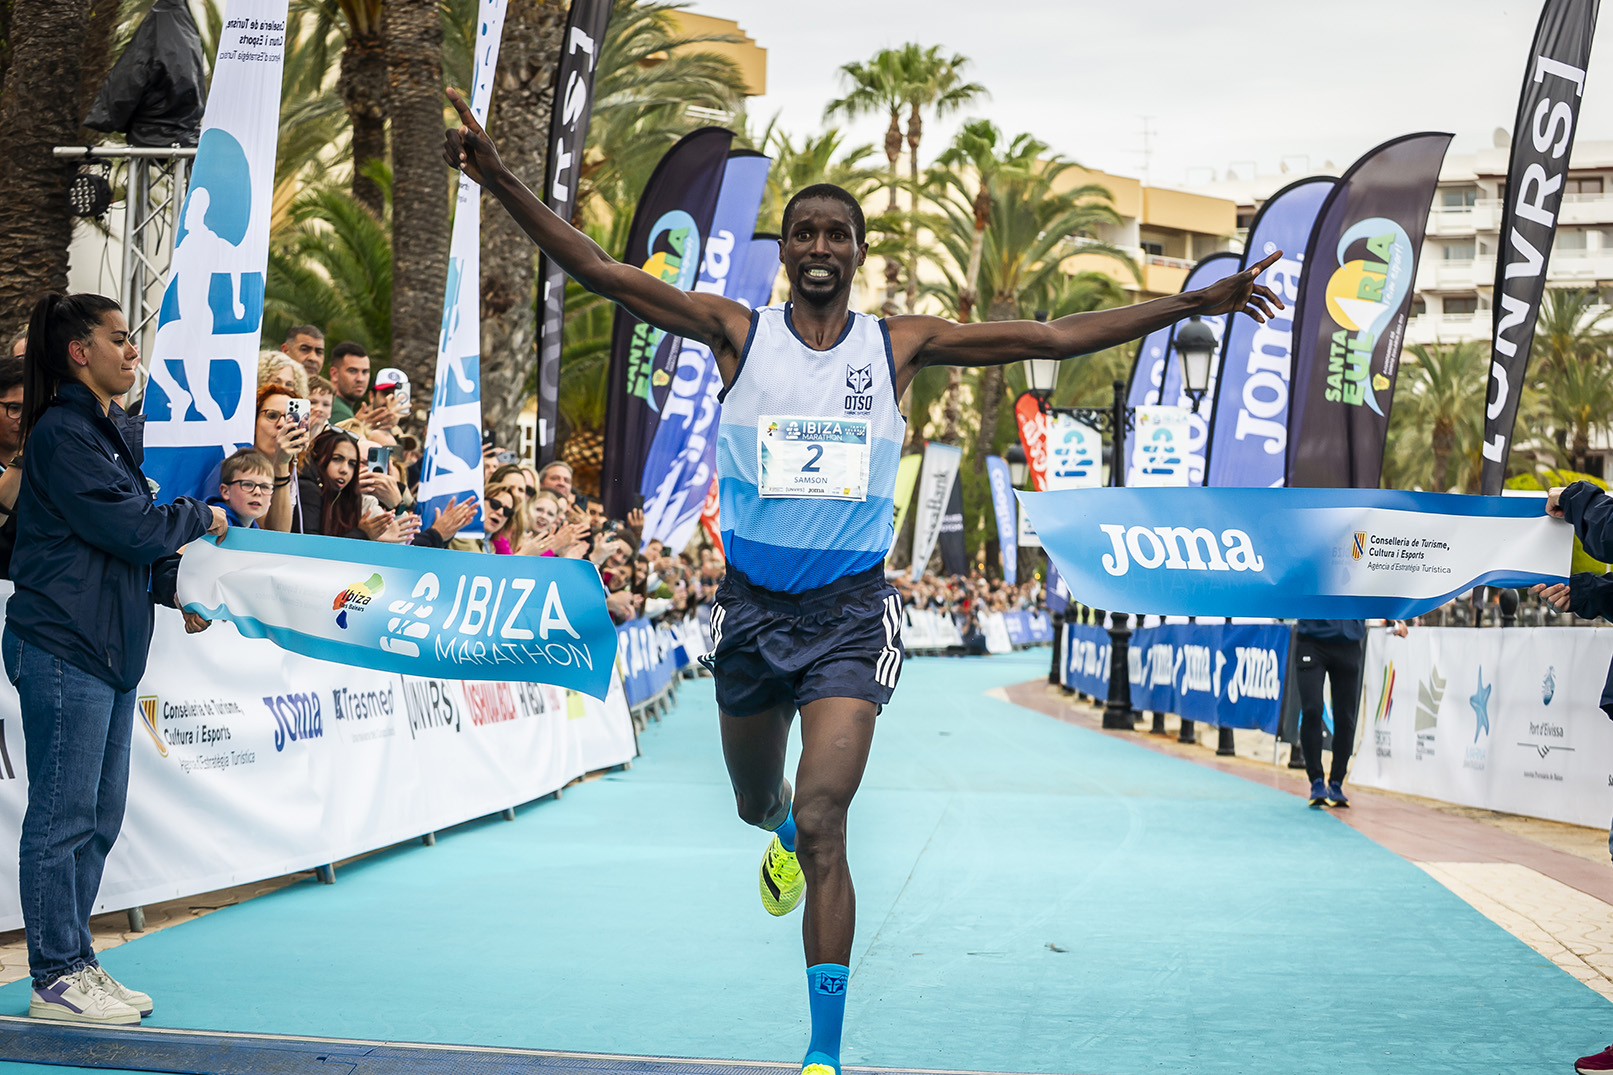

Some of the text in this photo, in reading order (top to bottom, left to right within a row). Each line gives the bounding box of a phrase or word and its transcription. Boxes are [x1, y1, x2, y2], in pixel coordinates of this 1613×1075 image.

[1325, 329, 1348, 403] SANTA
[844, 395, 873, 411] OTSO
[802, 421, 843, 435] IBIZA
[802, 433, 843, 441] MARATHON
[801, 444, 824, 473] 2
[794, 476, 828, 484] SAMSON
[1099, 523, 1264, 577] Joma
[1370, 534, 1450, 551] Conselleria de Turisme,
[1368, 547, 1425, 561] Cultura i Esports
[1367, 562, 1390, 572] Agència
[1422, 564, 1452, 574] Turística
[341, 589, 372, 605] Ibiza
[442, 574, 581, 641] IBIZA
[435, 634, 594, 671] MARATHON
[163, 700, 205, 720] Conselleria
[342, 681, 394, 721] Trasmed
[262, 691, 323, 752] Joma
[164, 723, 232, 746] Cultura i Esports
